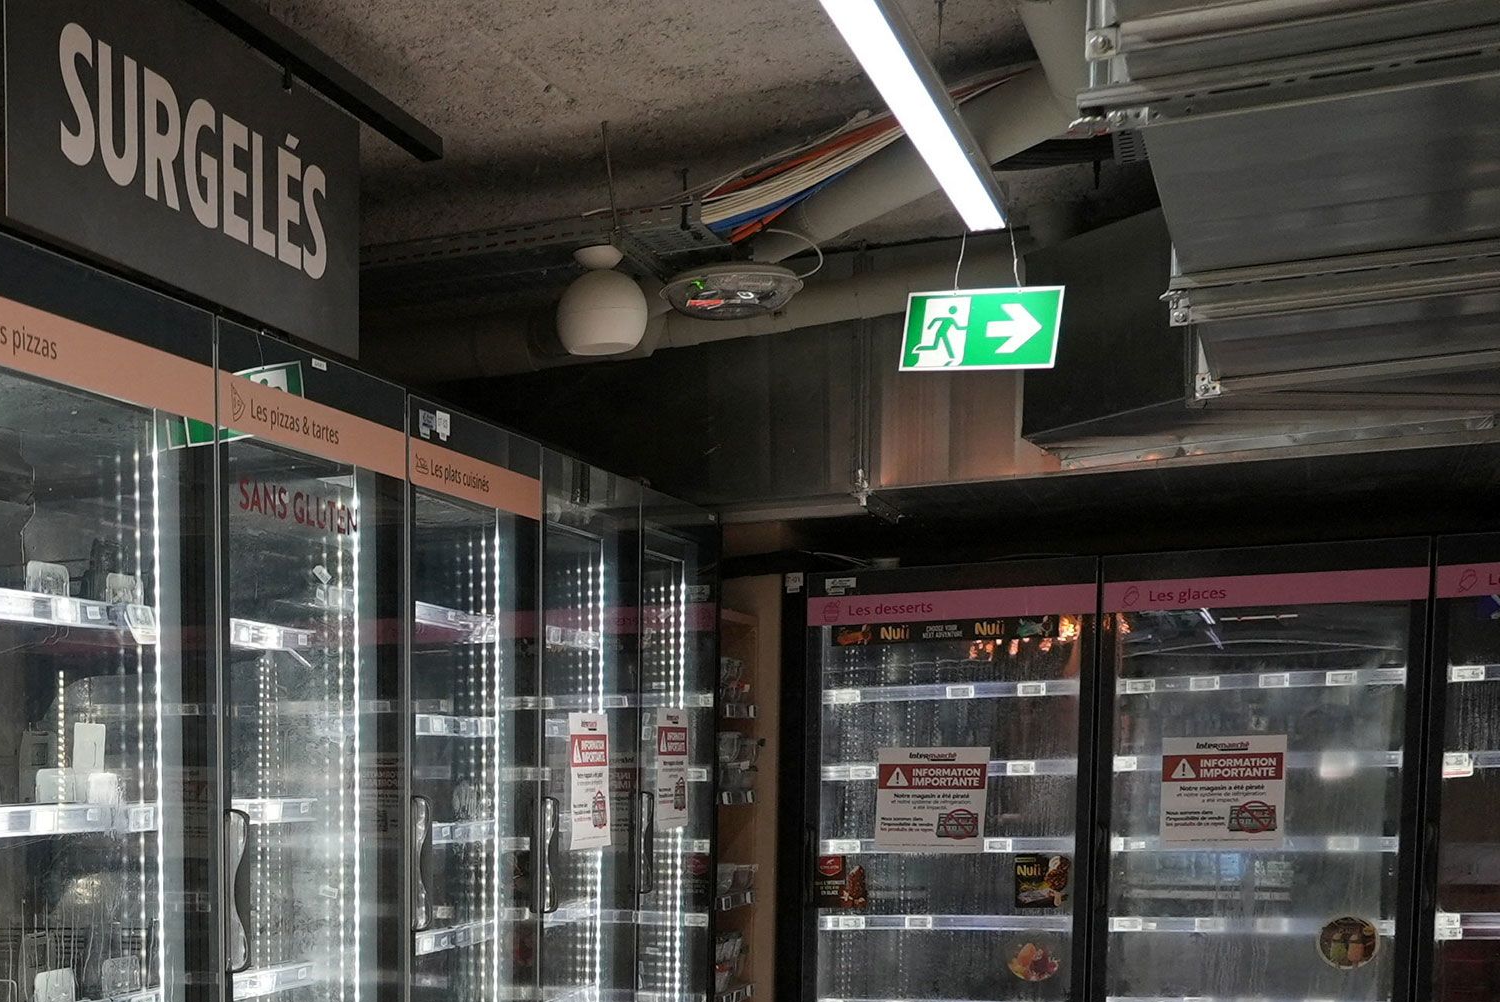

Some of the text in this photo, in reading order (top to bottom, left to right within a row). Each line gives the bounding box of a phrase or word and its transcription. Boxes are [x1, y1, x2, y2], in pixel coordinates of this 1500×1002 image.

[59, 22, 327, 280] SURGELÉS
[12, 325, 58, 360] pizzas
[251, 398, 340, 445] Les pizzas & tartes
[430, 459, 490, 493] Les plats cuisinés
[238, 475, 358, 536] SANS GLUTEN
[1489, 573, 1500, 586] L
[1149, 587, 1228, 604] Les glaces
[848, 602, 933, 617] Les desserts
[1200, 757, 1277, 767] INFORMATION
[912, 768, 981, 777] INFORMATION
[1200, 767, 1276, 778] IMPORTANTE
[911, 777, 980, 787] IMPORTANTE
